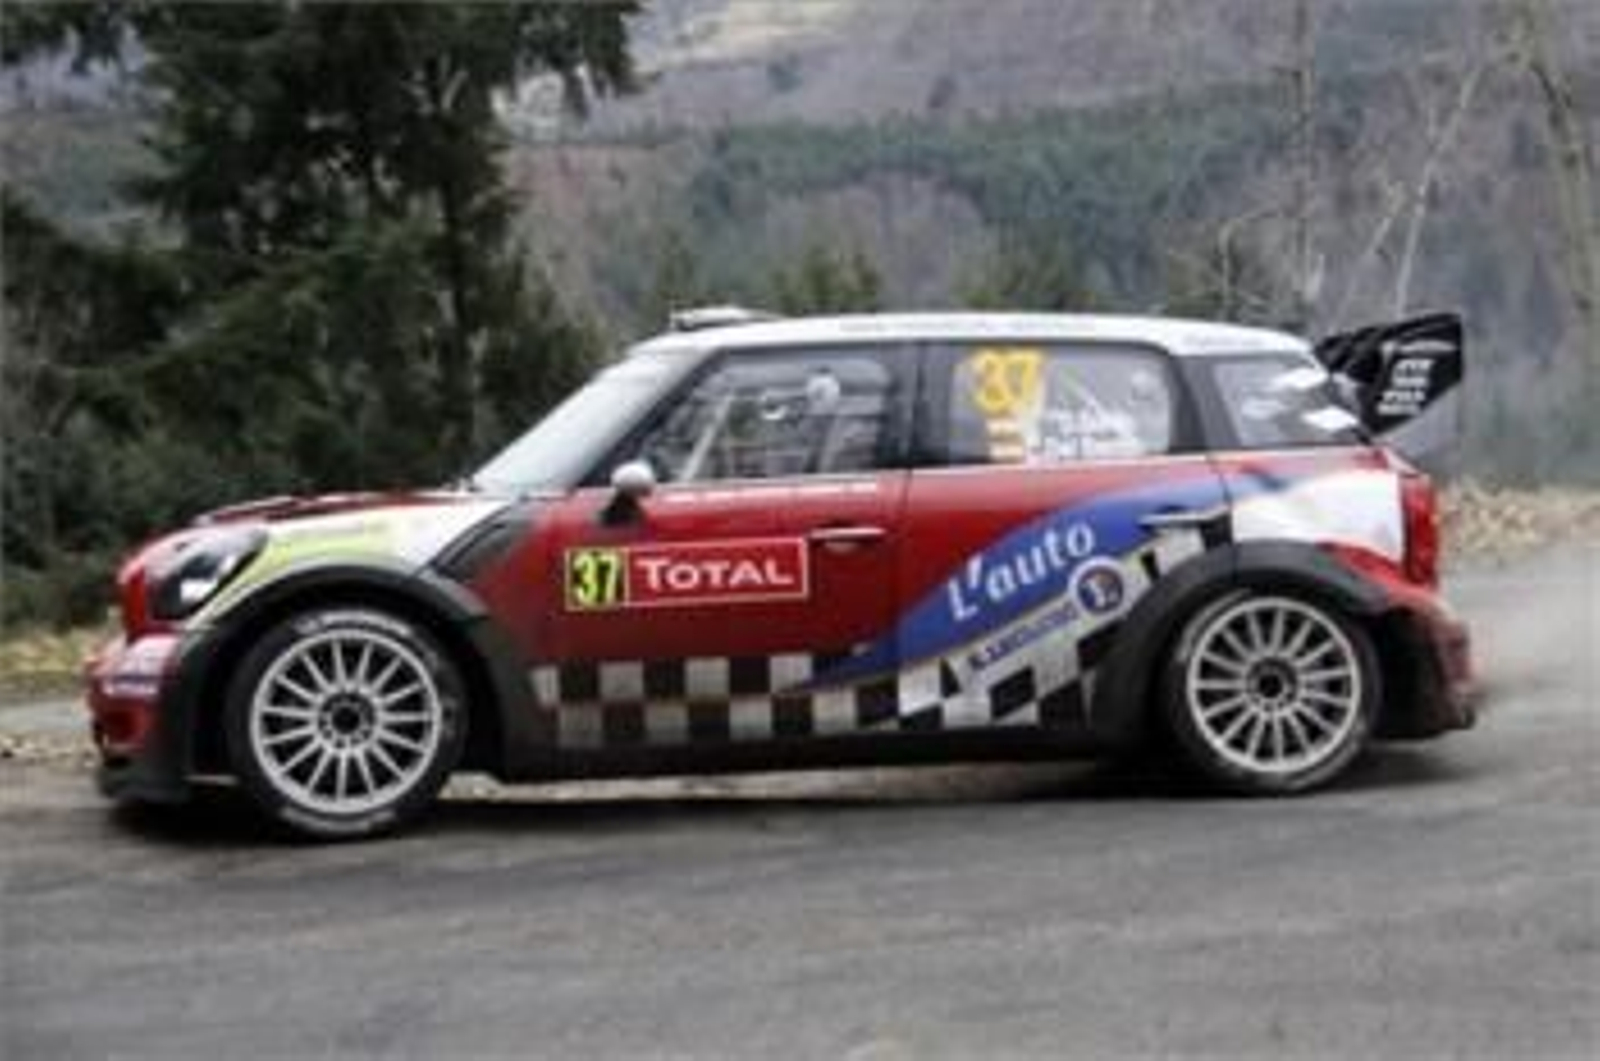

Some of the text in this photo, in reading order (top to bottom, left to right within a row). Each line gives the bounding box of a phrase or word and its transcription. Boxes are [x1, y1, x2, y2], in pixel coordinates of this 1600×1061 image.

[973, 348, 1043, 415] 37
[572, 551, 620, 606] 37
[634, 558, 794, 590] TOTAL
[948, 522, 1096, 621] L'auto
